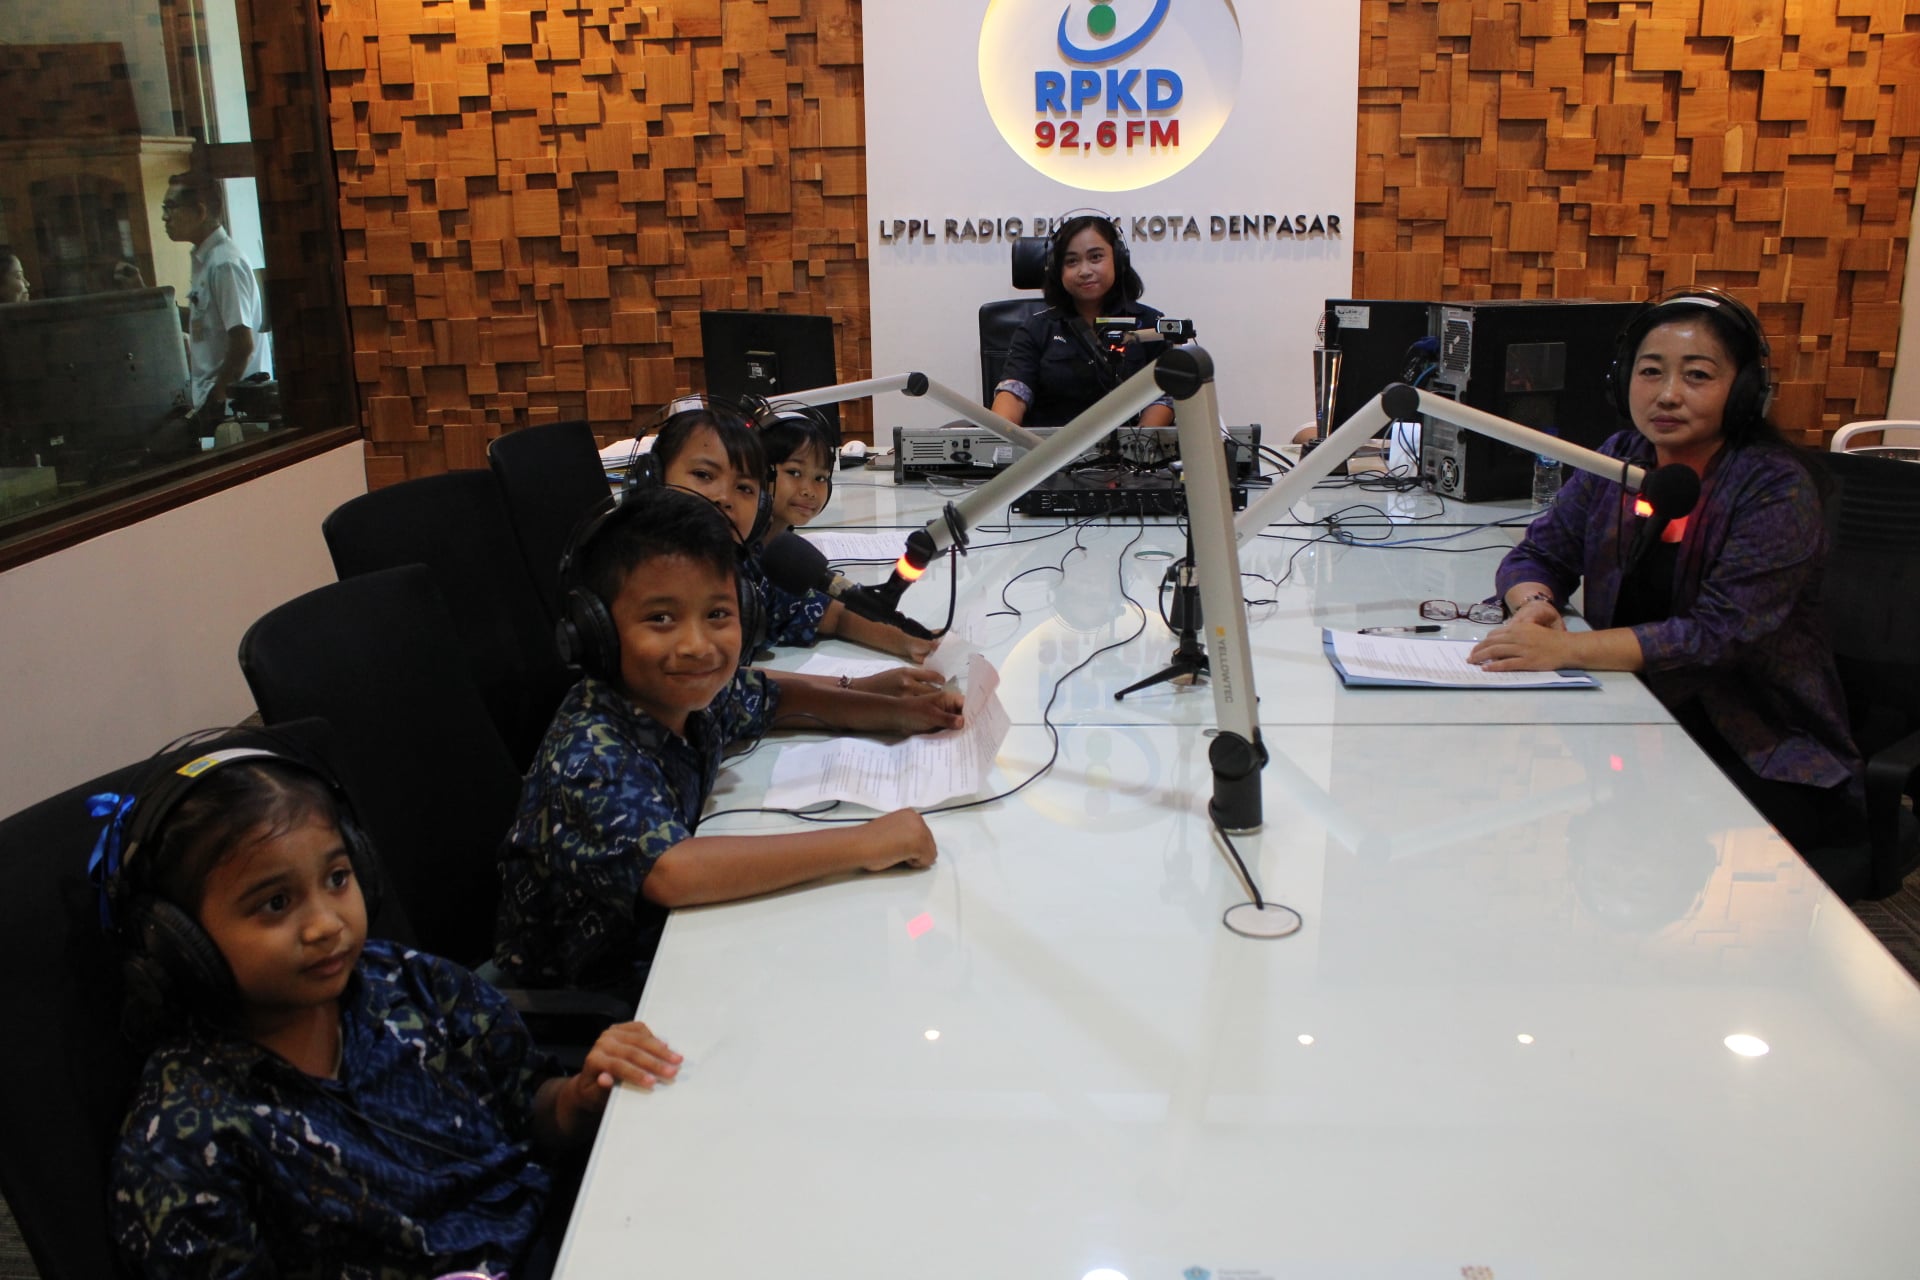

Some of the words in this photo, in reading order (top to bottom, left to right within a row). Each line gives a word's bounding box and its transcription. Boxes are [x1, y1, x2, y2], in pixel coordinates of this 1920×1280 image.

[1035, 69, 1183, 112] RPKD
[1126, 119, 1180, 148] FM
[880, 218, 936, 241] LPPL
[945, 216, 1024, 241] RADIO
[1132, 215, 1201, 240] KOTA
[1210, 214, 1342, 237] DENPASAR
[1218, 639, 1234, 704] YELLOWTEC
